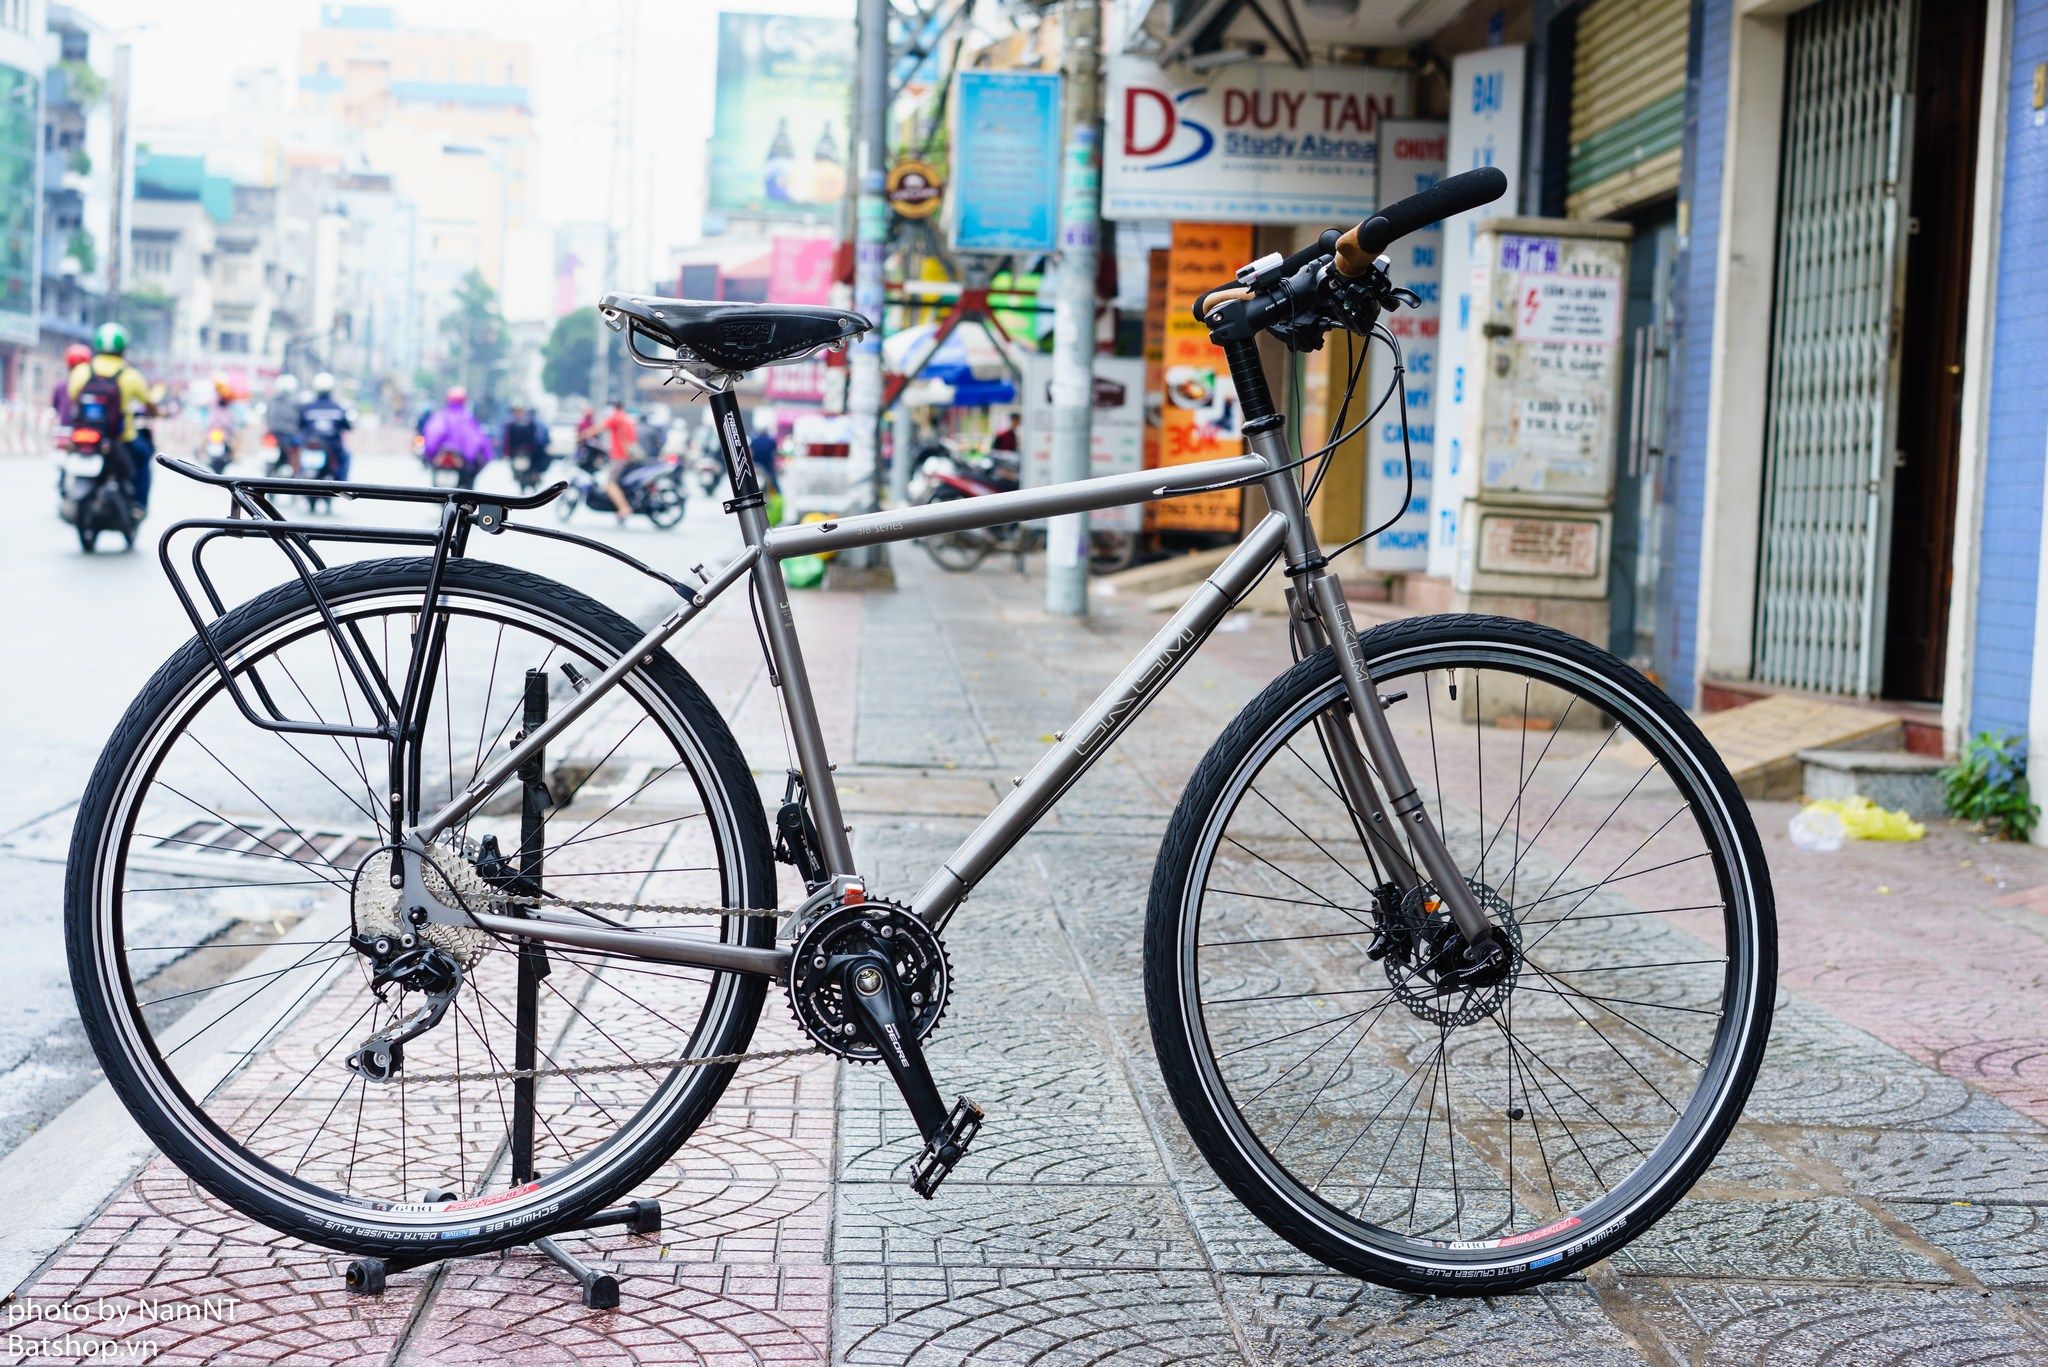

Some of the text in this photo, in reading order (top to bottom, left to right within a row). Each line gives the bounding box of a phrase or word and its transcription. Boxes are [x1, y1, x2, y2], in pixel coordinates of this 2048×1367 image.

[1223, 89, 1394, 132] DUY TAN
[1225, 132, 1296, 156] Study
[874, 521, 904, 534] series
[884, 1023, 910, 1068] DEORE
[486, 1203, 559, 1233] SCHWALBE
[325, 1219, 353, 1235] PLUS
[355, 1228, 401, 1241] CRUISER
[402, 1231, 438, 1241] DELTA
[1567, 1216, 1628, 1258] SCHWALBE
[1425, 1267, 1453, 1279] PLUS
[1454, 1268, 1496, 1279] CRUISER
[1499, 1263, 1527, 1275] DELTA
